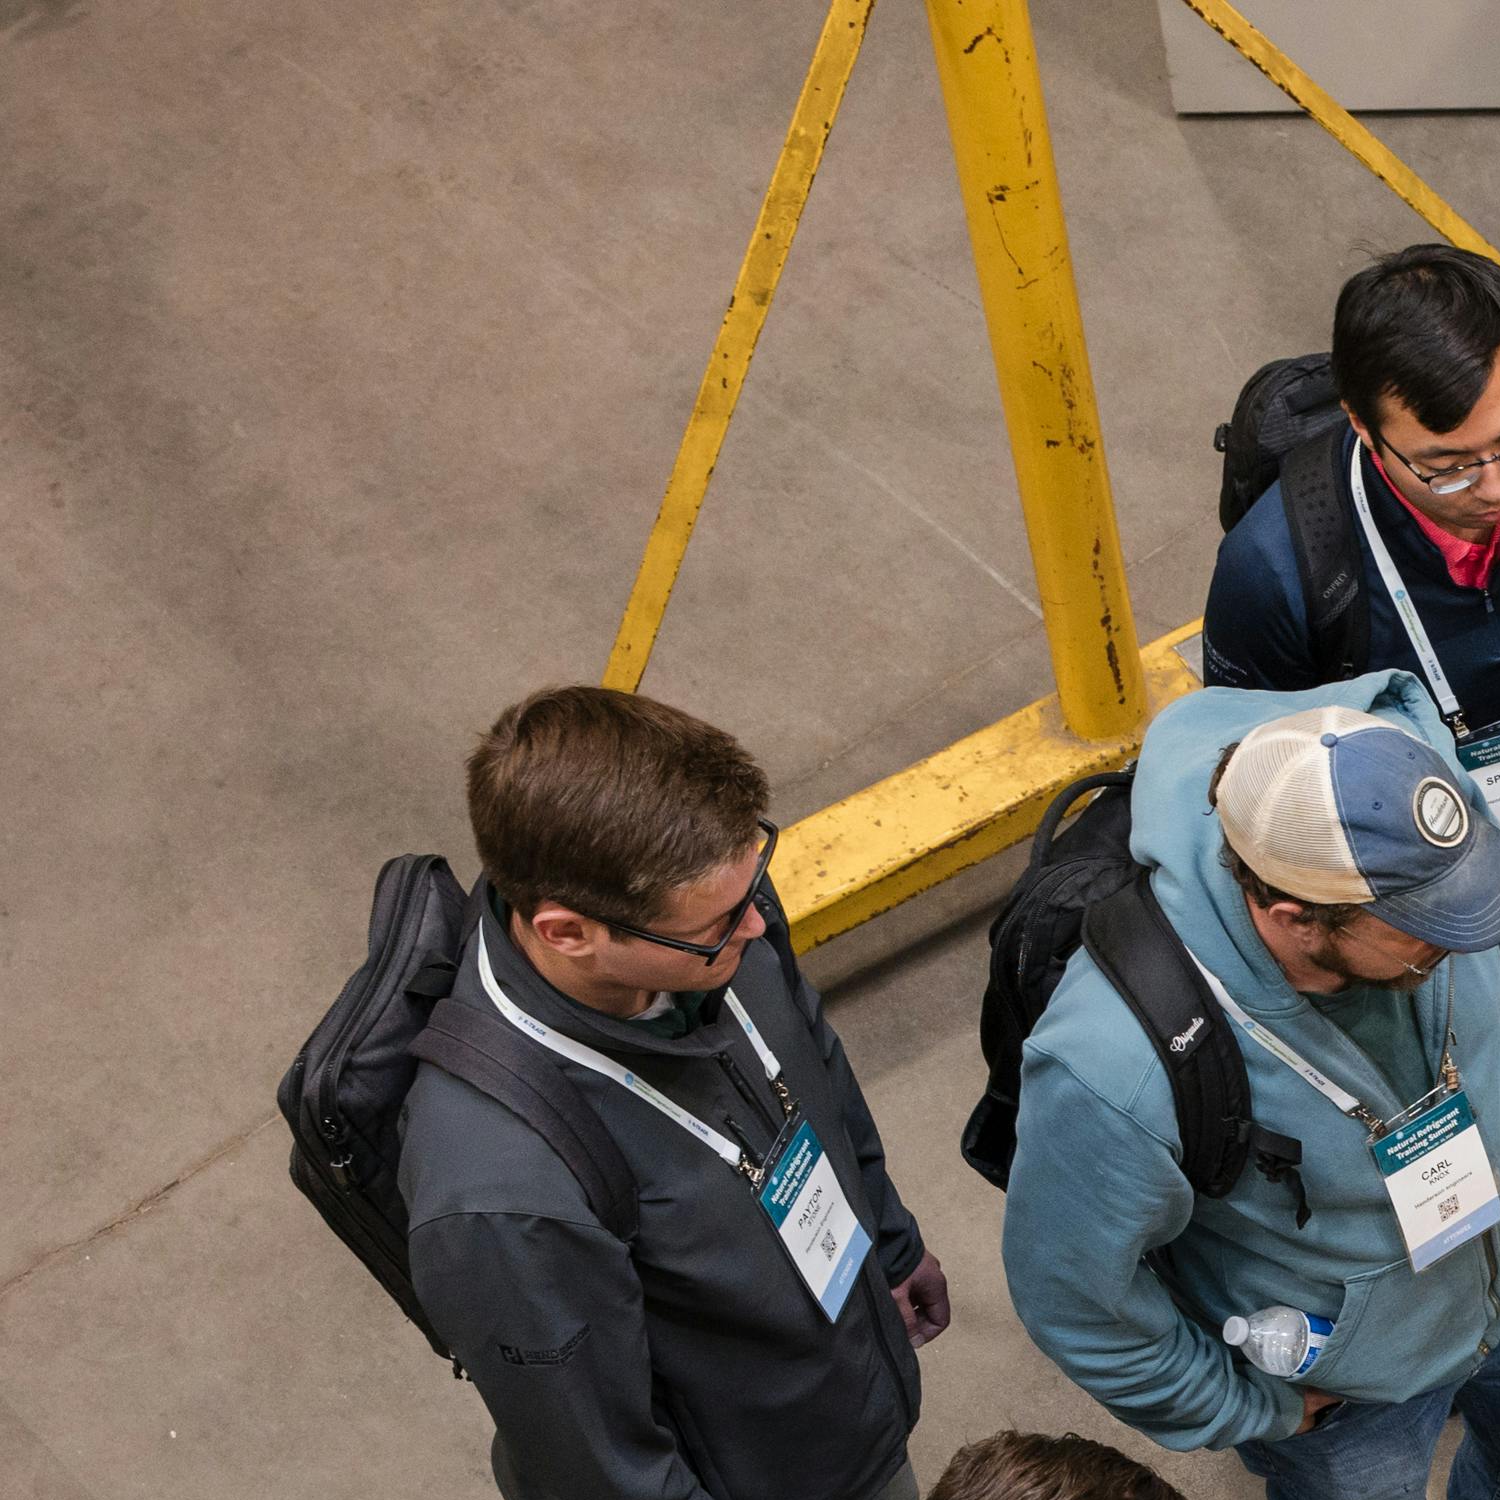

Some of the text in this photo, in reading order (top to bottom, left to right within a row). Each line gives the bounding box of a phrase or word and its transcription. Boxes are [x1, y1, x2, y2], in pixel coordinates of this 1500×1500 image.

[1322, 570, 1348, 598] OSPREY
[1470, 745, 1500, 757] Natural
[1385, 1133, 1417, 1156] Natural
[1415, 1106, 1461, 1139] Refrigerant
[1395, 1136, 1429, 1161] Training
[1426, 1118, 1459, 1141] Summit
[769, 1176, 790, 1204] Natural
[782, 1138, 813, 1179] Refrigerant
[776, 1176, 799, 1206] Training
[792, 1150, 814, 1179] Summit
[1419, 1157, 1452, 1181] CARL
[1428, 1168, 1450, 1185] KNOX
[794, 1185, 826, 1229] PAYTON
